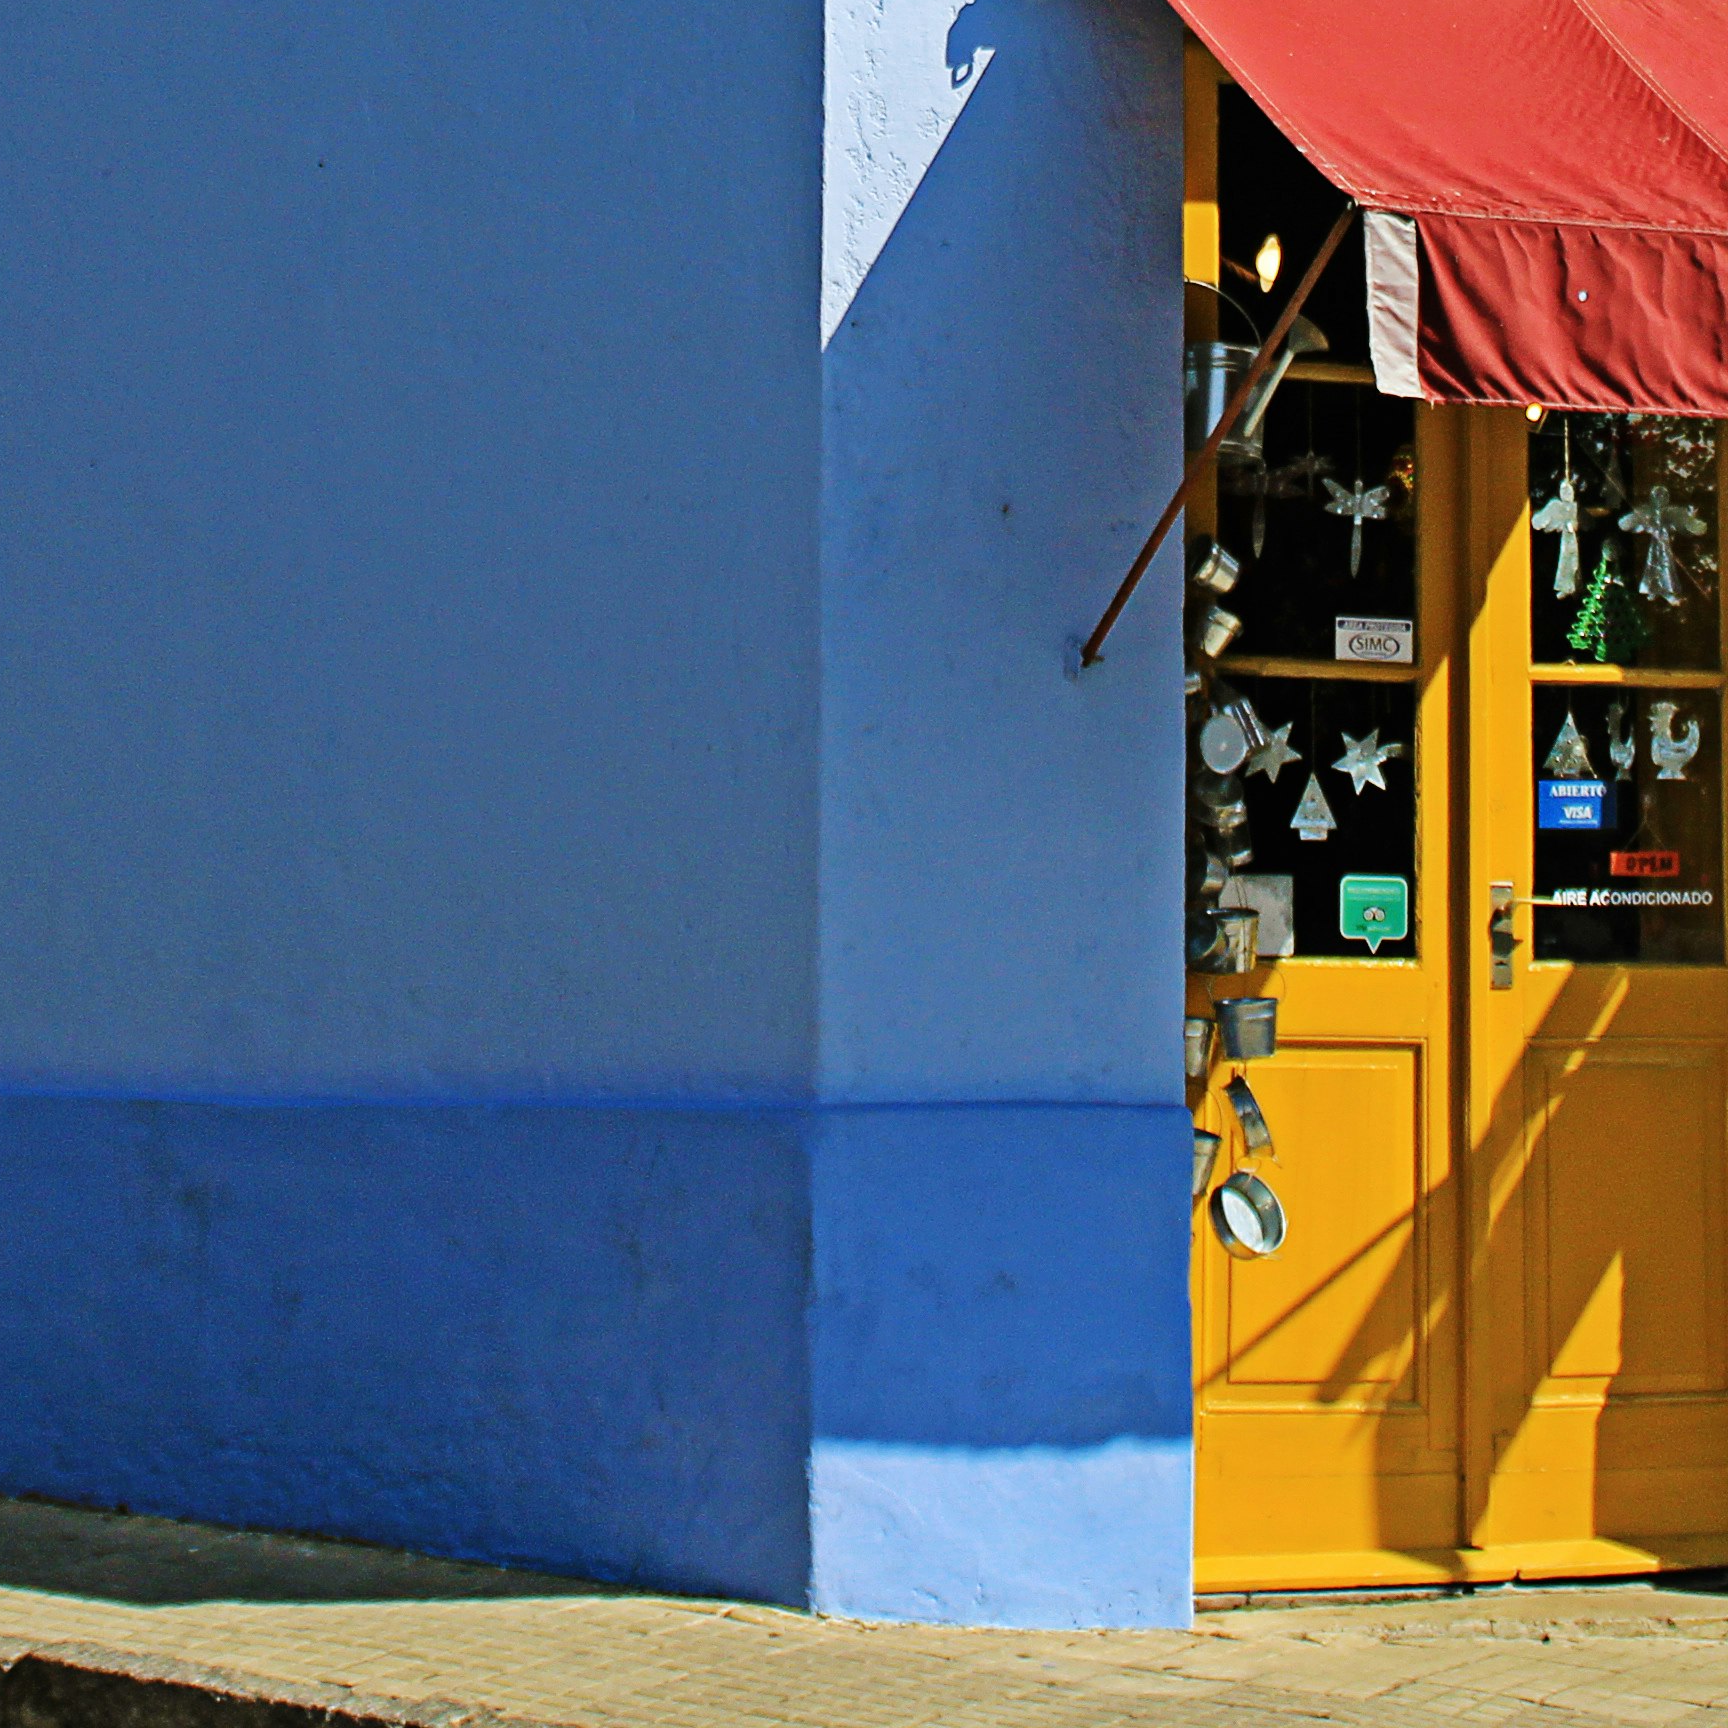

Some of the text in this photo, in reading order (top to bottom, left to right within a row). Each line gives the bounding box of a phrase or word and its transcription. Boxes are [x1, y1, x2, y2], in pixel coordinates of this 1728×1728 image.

[1548, 784, 1607, 798] ABIERTO
[1562, 805, 1594, 820] VISA
[1551, 889, 1714, 906] AIRE ACONDICIONADO
